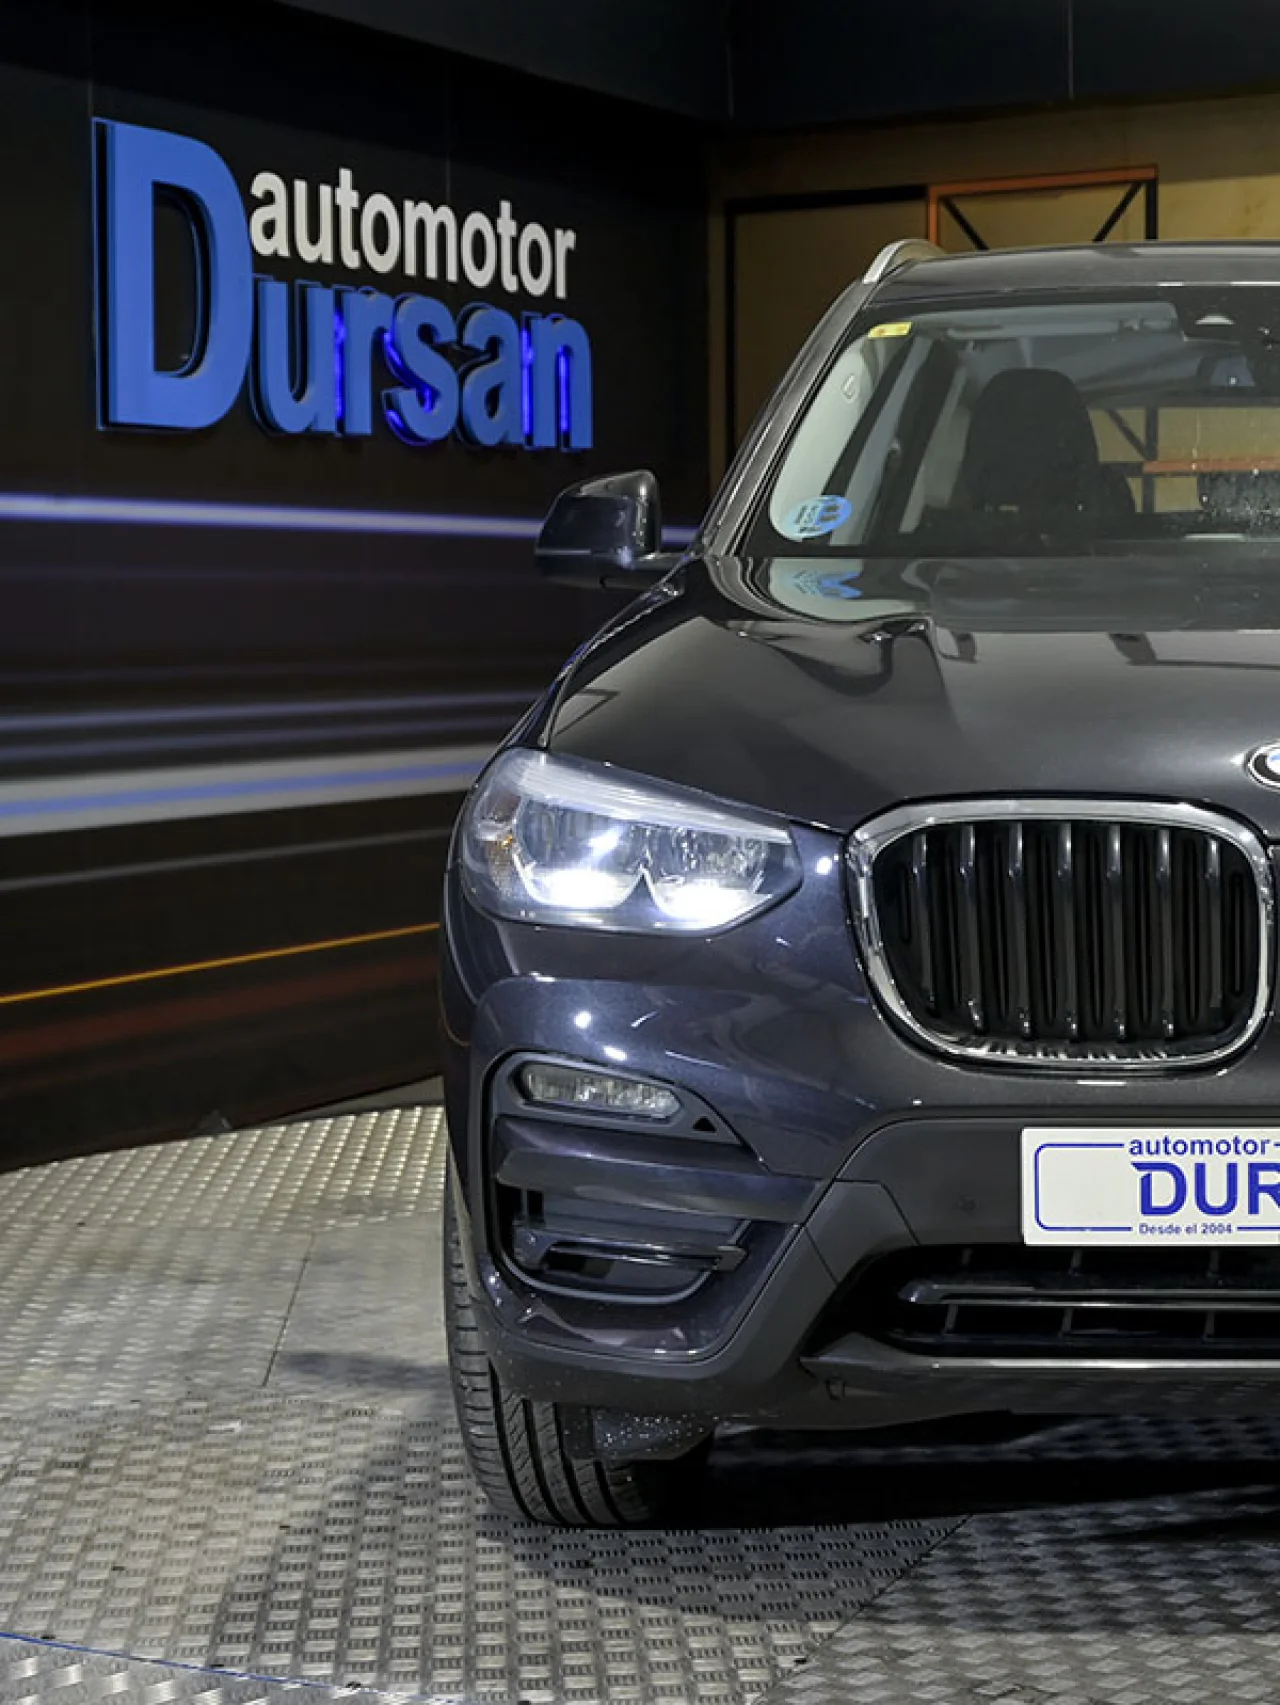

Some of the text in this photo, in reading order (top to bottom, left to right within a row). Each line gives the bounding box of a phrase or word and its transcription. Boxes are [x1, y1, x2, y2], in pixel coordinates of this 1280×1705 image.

[249, 167, 576, 299] automotor
[92, 117, 594, 450] Dursan
[1128, 1135, 1270, 1156] automotor
[1139, 1222, 1233, 1235] Desde el 2004
